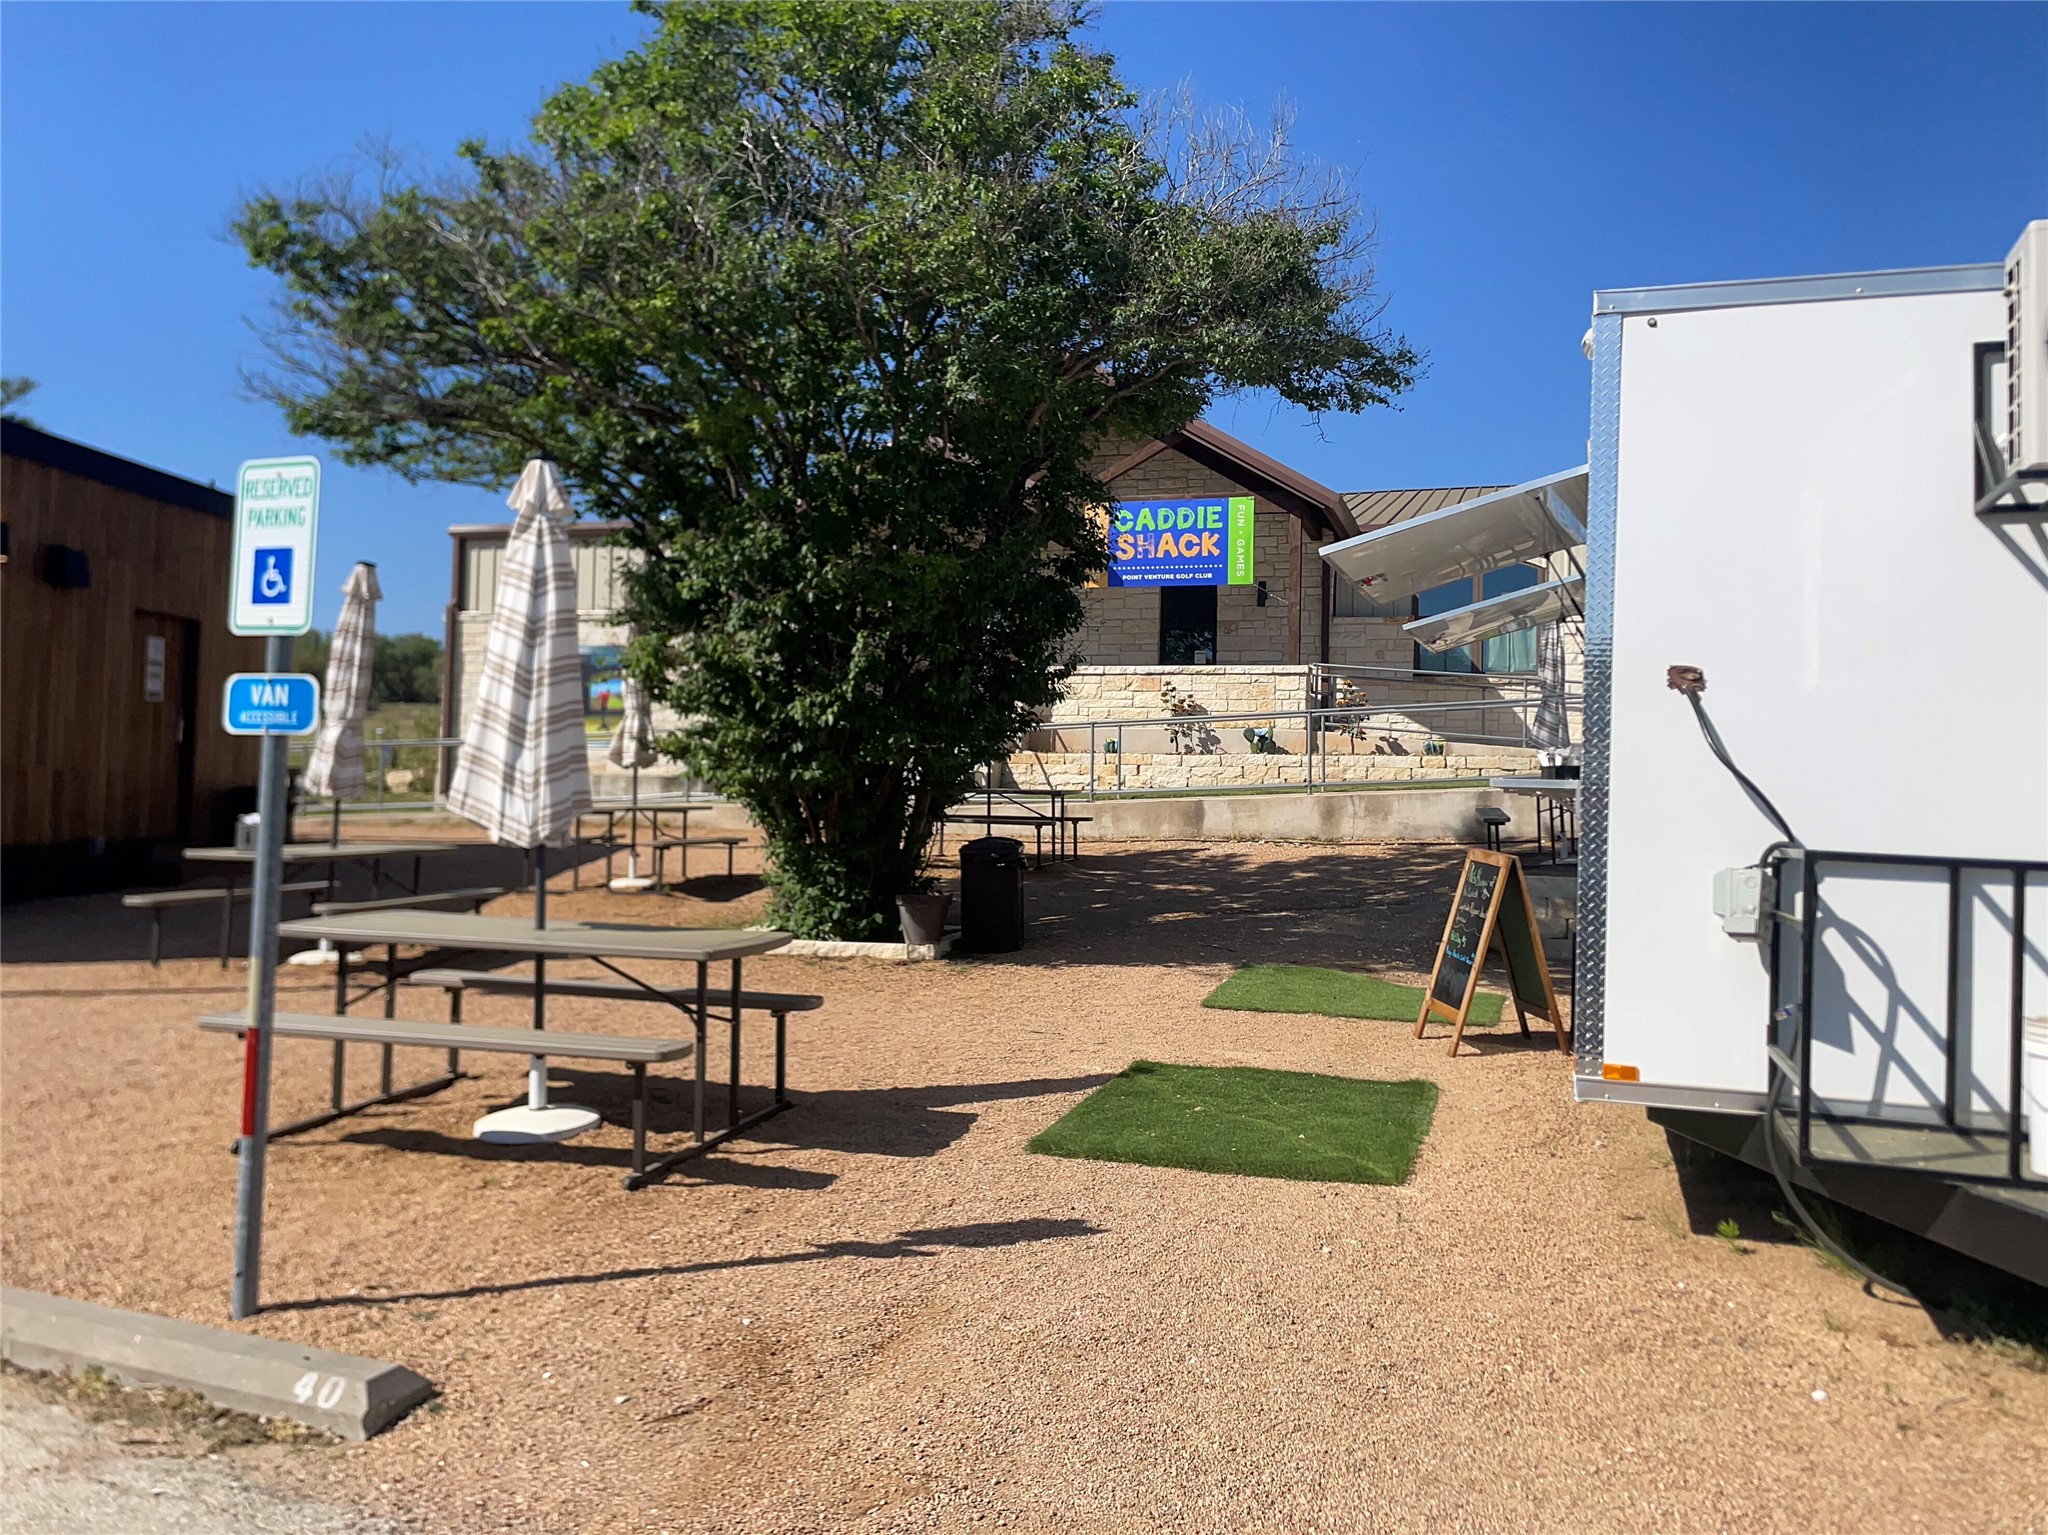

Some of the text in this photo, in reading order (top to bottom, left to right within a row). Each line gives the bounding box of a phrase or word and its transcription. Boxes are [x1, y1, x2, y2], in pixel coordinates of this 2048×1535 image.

[246, 476, 312, 499] RESERVED
[248, 505, 306, 528] PARKING
[1115, 506, 1223, 532] CADDIE
[1116, 531, 1220, 560] SHACK
[1236, 504, 1245, 577] FUN GAMES
[1175, 572, 1194, 580] GOLF
[250, 683, 289, 707] VAN
[293, 1371, 346, 1409] 40
